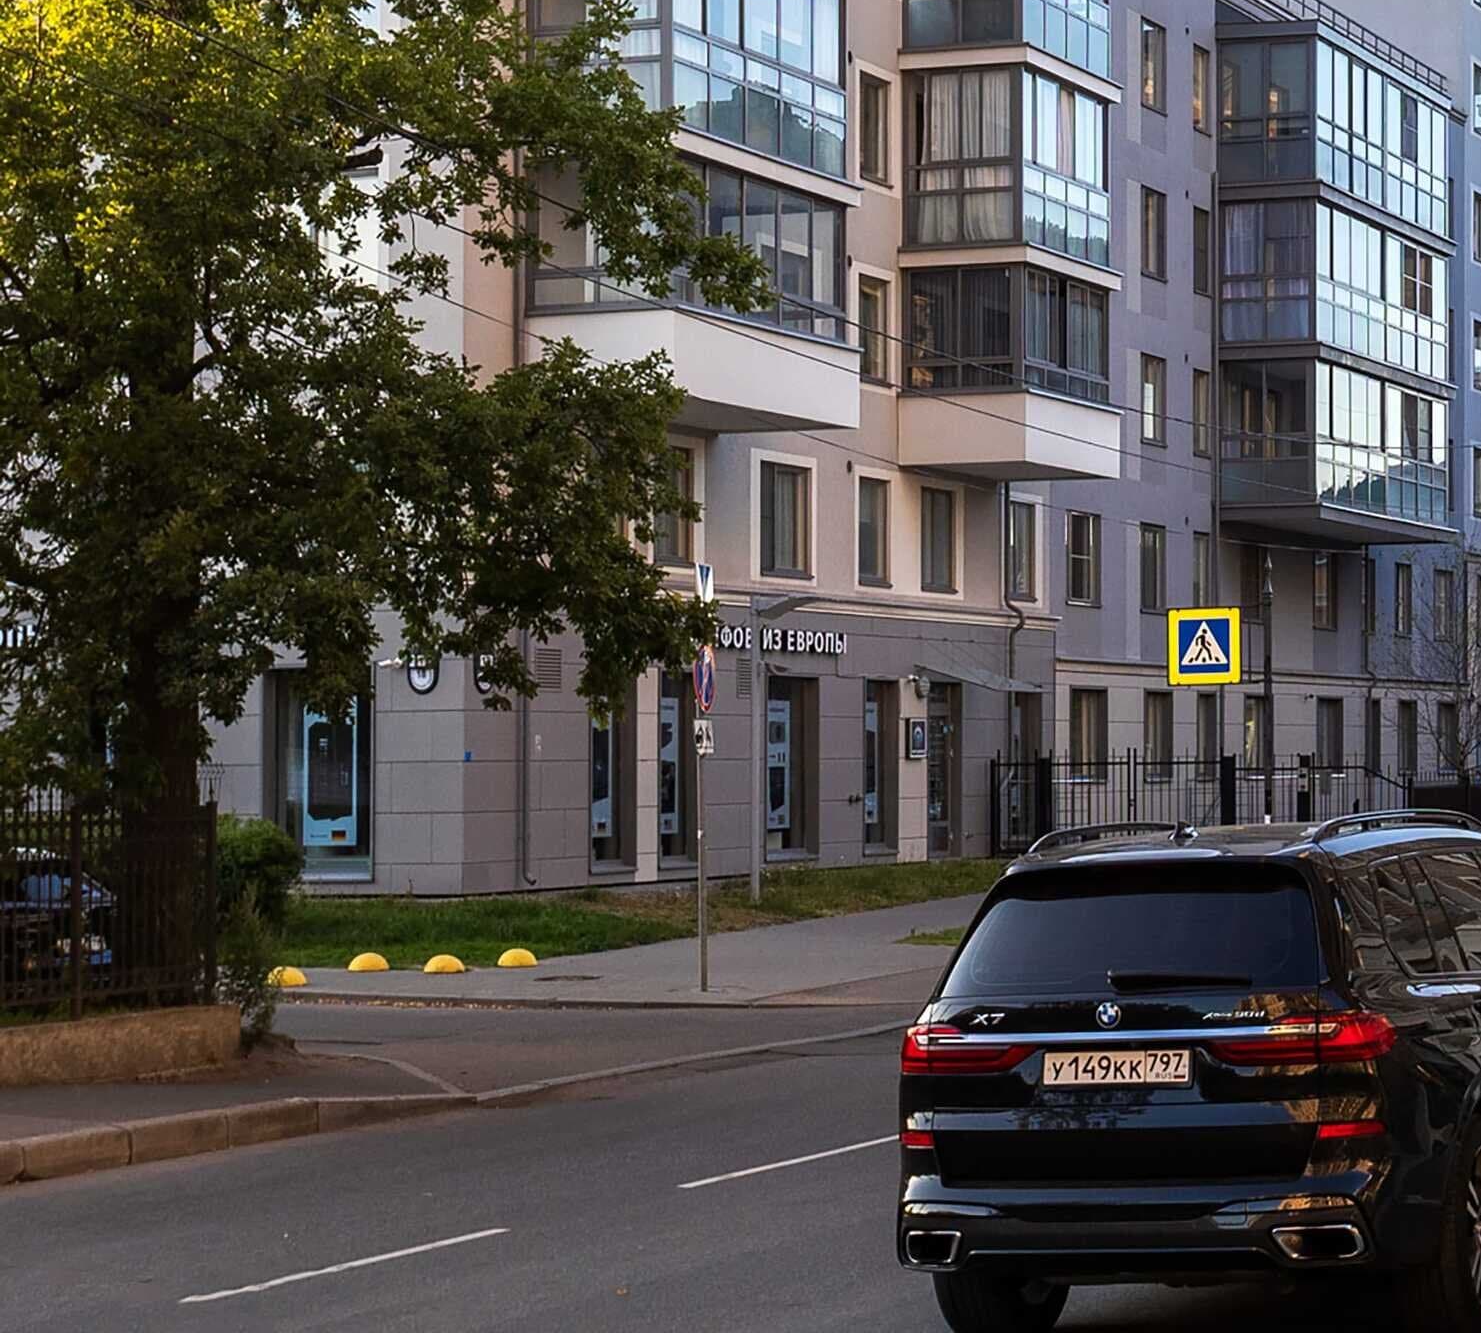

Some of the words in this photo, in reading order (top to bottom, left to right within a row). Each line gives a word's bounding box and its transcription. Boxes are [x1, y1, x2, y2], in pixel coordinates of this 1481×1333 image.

[762, 627, 782, 651] ИЗ
[787, 631, 848, 654] ЕВРОПЫ
[969, 1012, 1005, 1026] X7
[1147, 1052, 1184, 1072] 797
